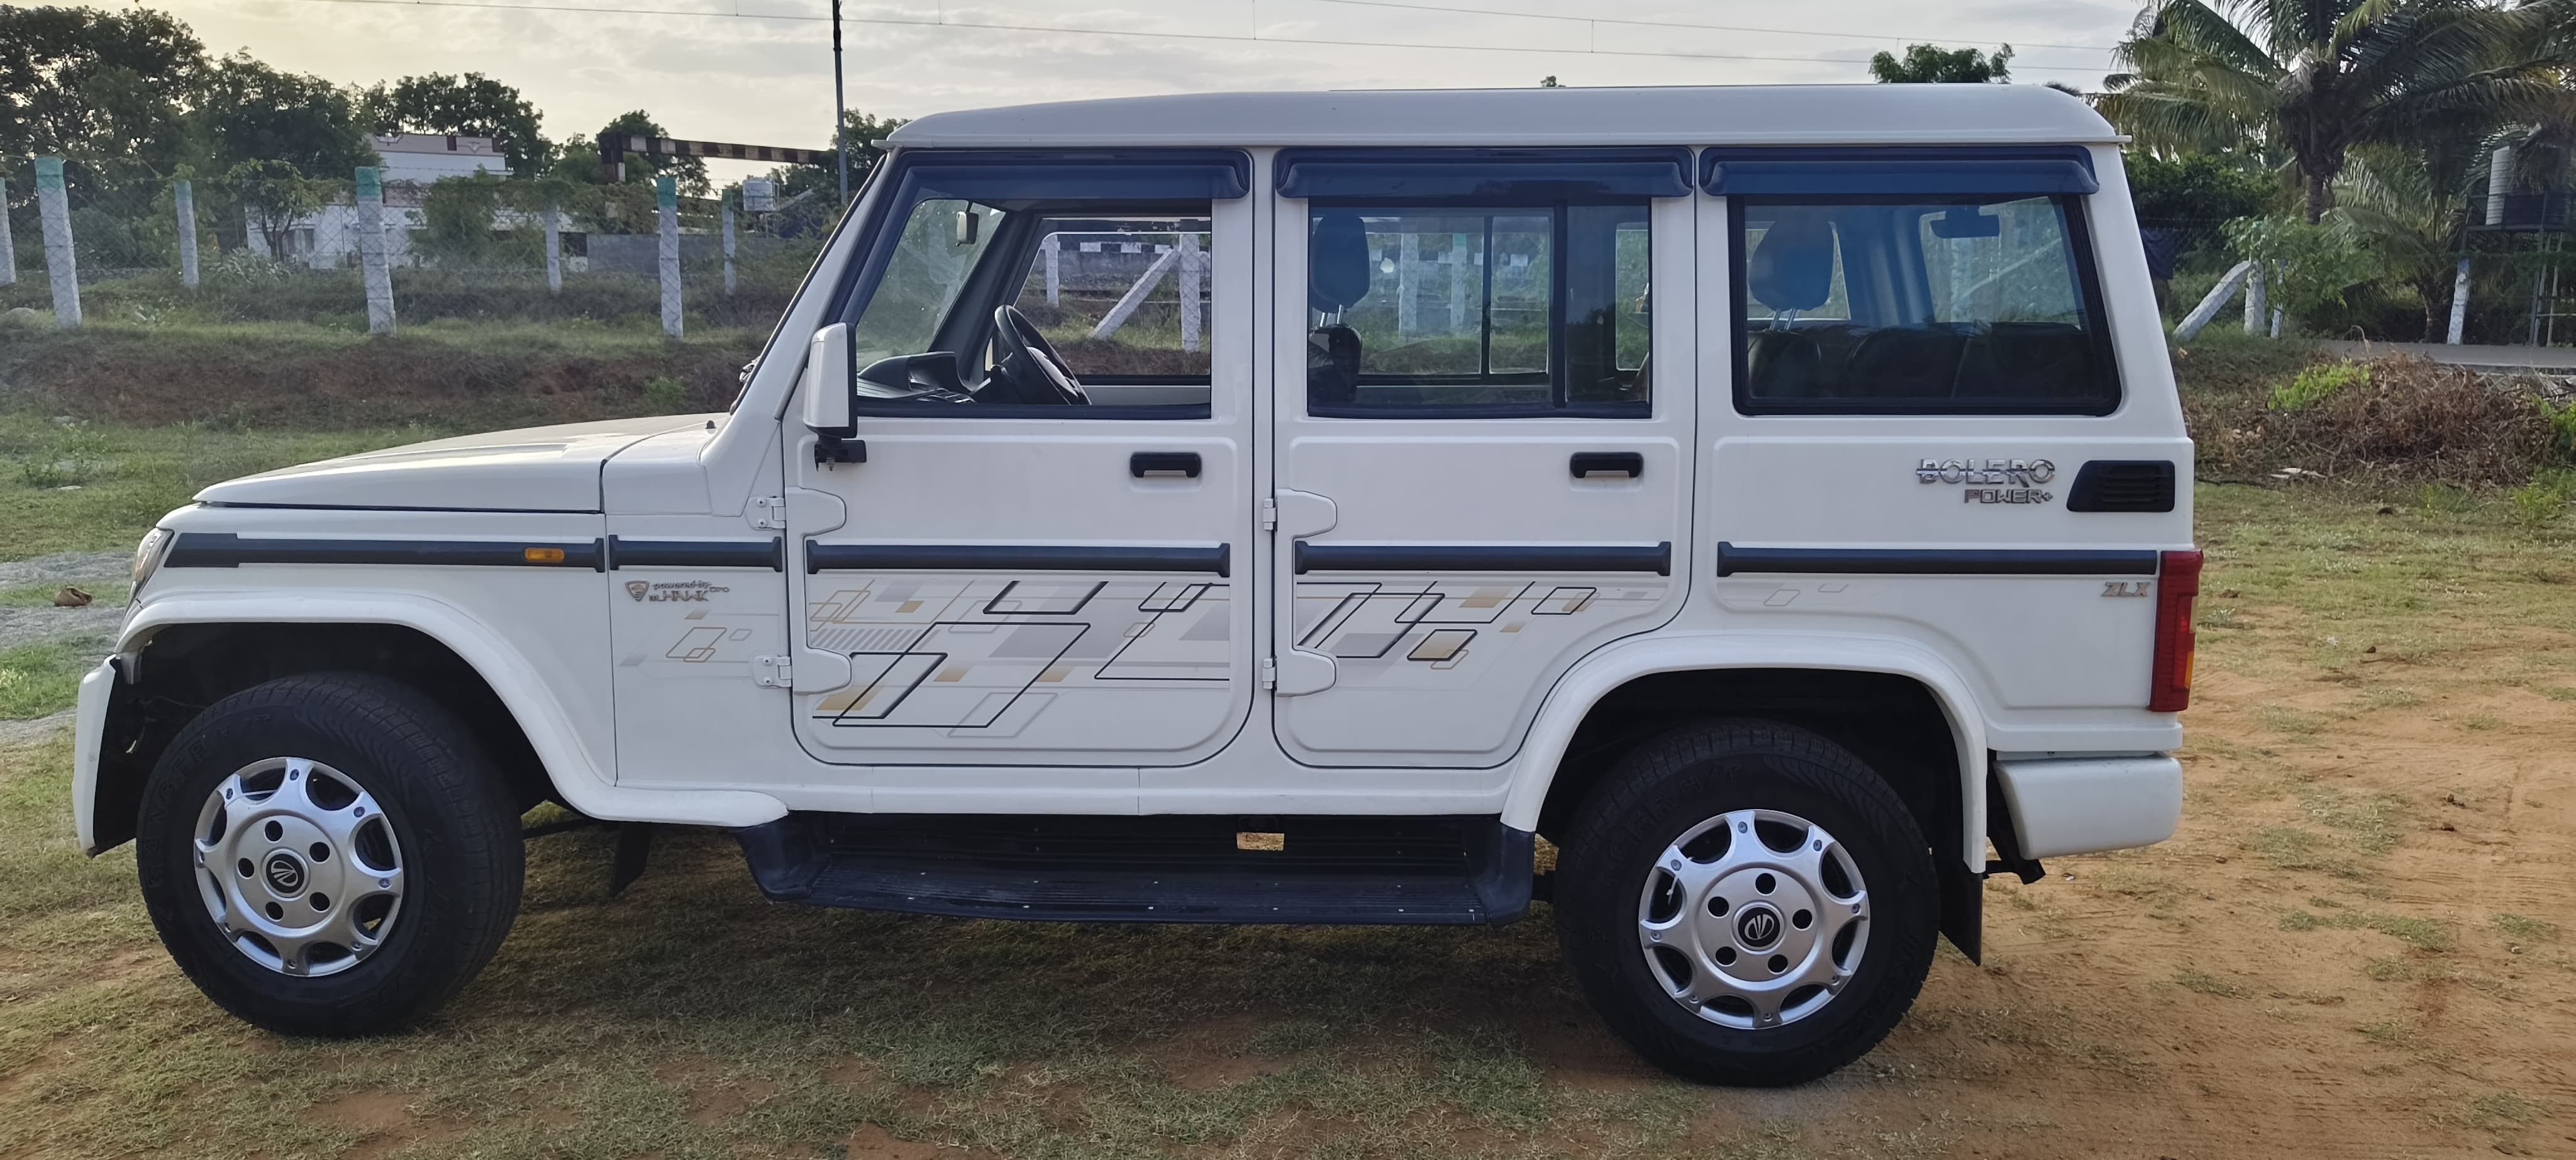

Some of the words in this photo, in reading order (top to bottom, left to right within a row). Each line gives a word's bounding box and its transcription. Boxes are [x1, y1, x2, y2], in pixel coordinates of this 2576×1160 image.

[1916, 459, 2055, 488] BOLERO
[1964, 489, 2053, 503] POWER+
[2101, 581, 2151, 597] ZLX
